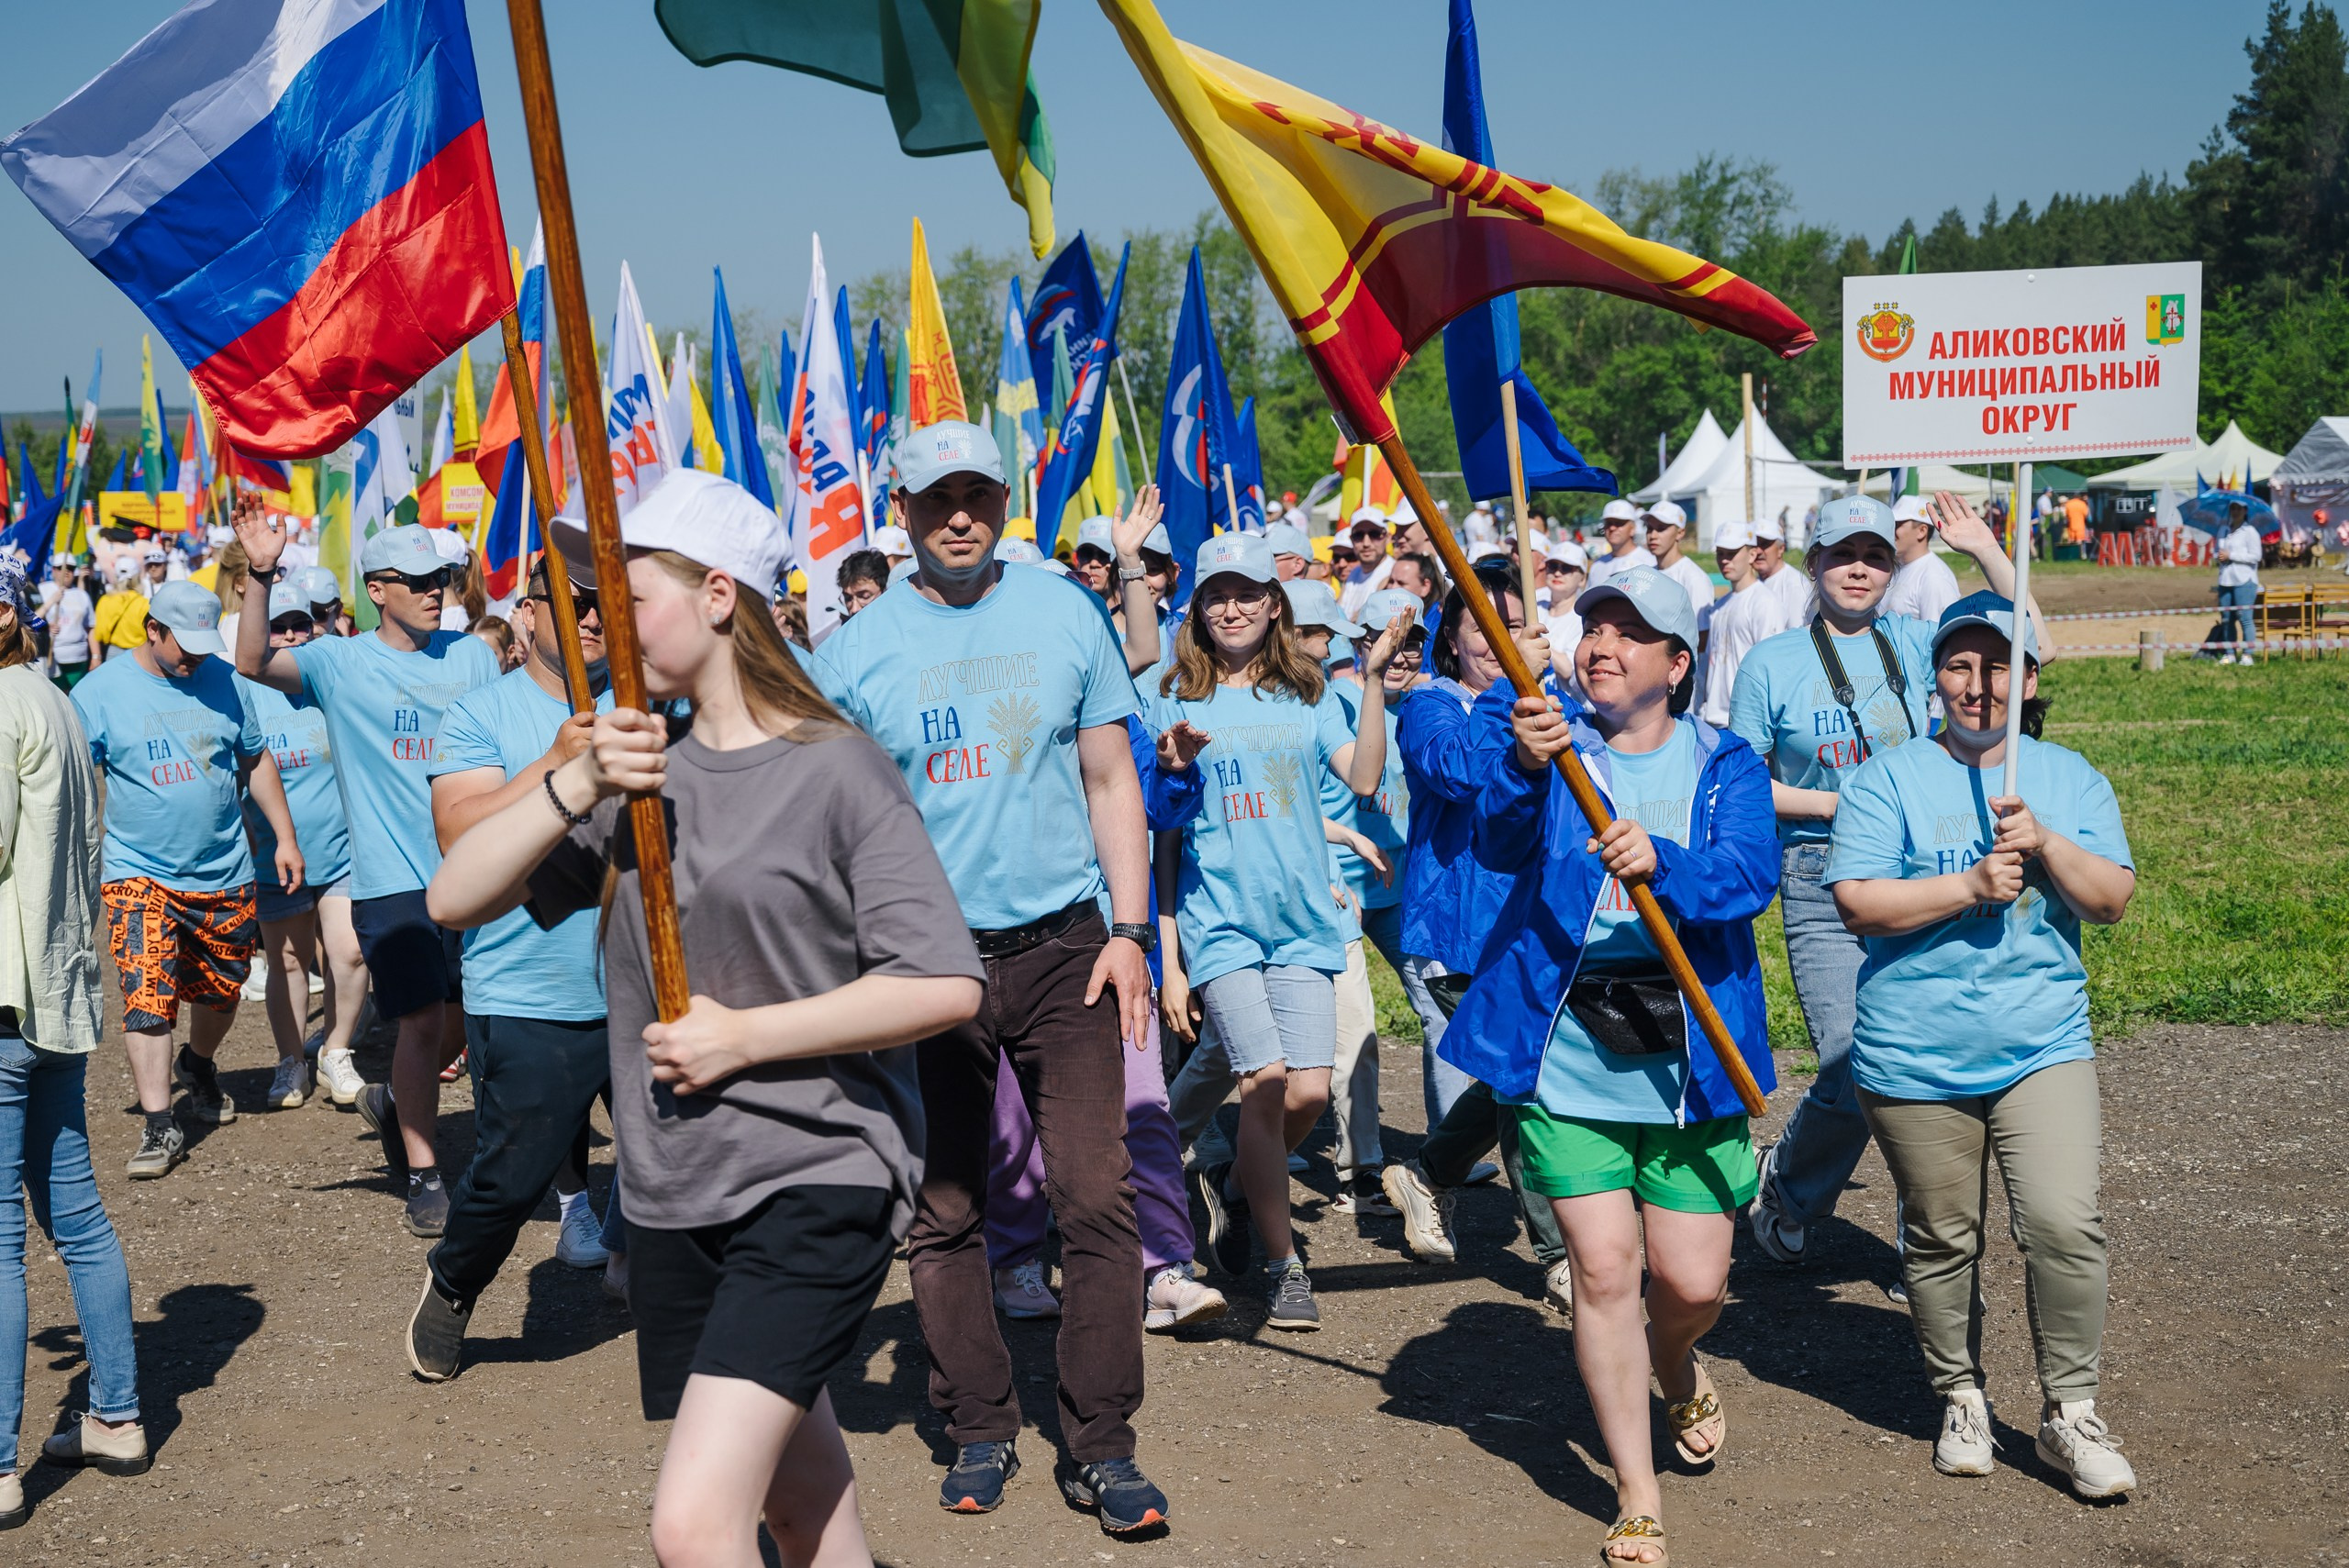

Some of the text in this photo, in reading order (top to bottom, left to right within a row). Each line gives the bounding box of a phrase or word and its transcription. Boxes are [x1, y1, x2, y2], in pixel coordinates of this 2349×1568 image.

[1929, 317, 2126, 360] АЛИКОВСКИЙ
[1889, 354, 2161, 401] МУНИЦИПАЛЬНЫЙ
[1982, 403, 2077, 436] ОКРУГ
[936, 428, 971, 441] ЛУЧШИЕ
[937, 440, 949, 451] НА
[939, 450, 960, 462] СЕЛЕ
[918, 652, 1041, 705] ЛУЧШИЕ
[144, 708, 217, 737] ЛУЧШИЕ
[265, 709, 327, 733] ЛУЧШИ
[395, 709, 419, 732] НА
[920, 706, 962, 744] НА
[1813, 708, 1846, 737] НА
[147, 739, 172, 761] НА
[265, 733, 287, 750] НА
[1210, 723, 1303, 757] ЛУЧШИЕ
[151, 760, 196, 786] СЕЛЕ
[277, 748, 310, 771] ЕЛЕ
[926, 743, 991, 784] СЕЛЕ
[1213, 758, 1242, 788] НА
[1222, 791, 1269, 823] СЕЛЕ
[1935, 849, 1974, 875] НА
